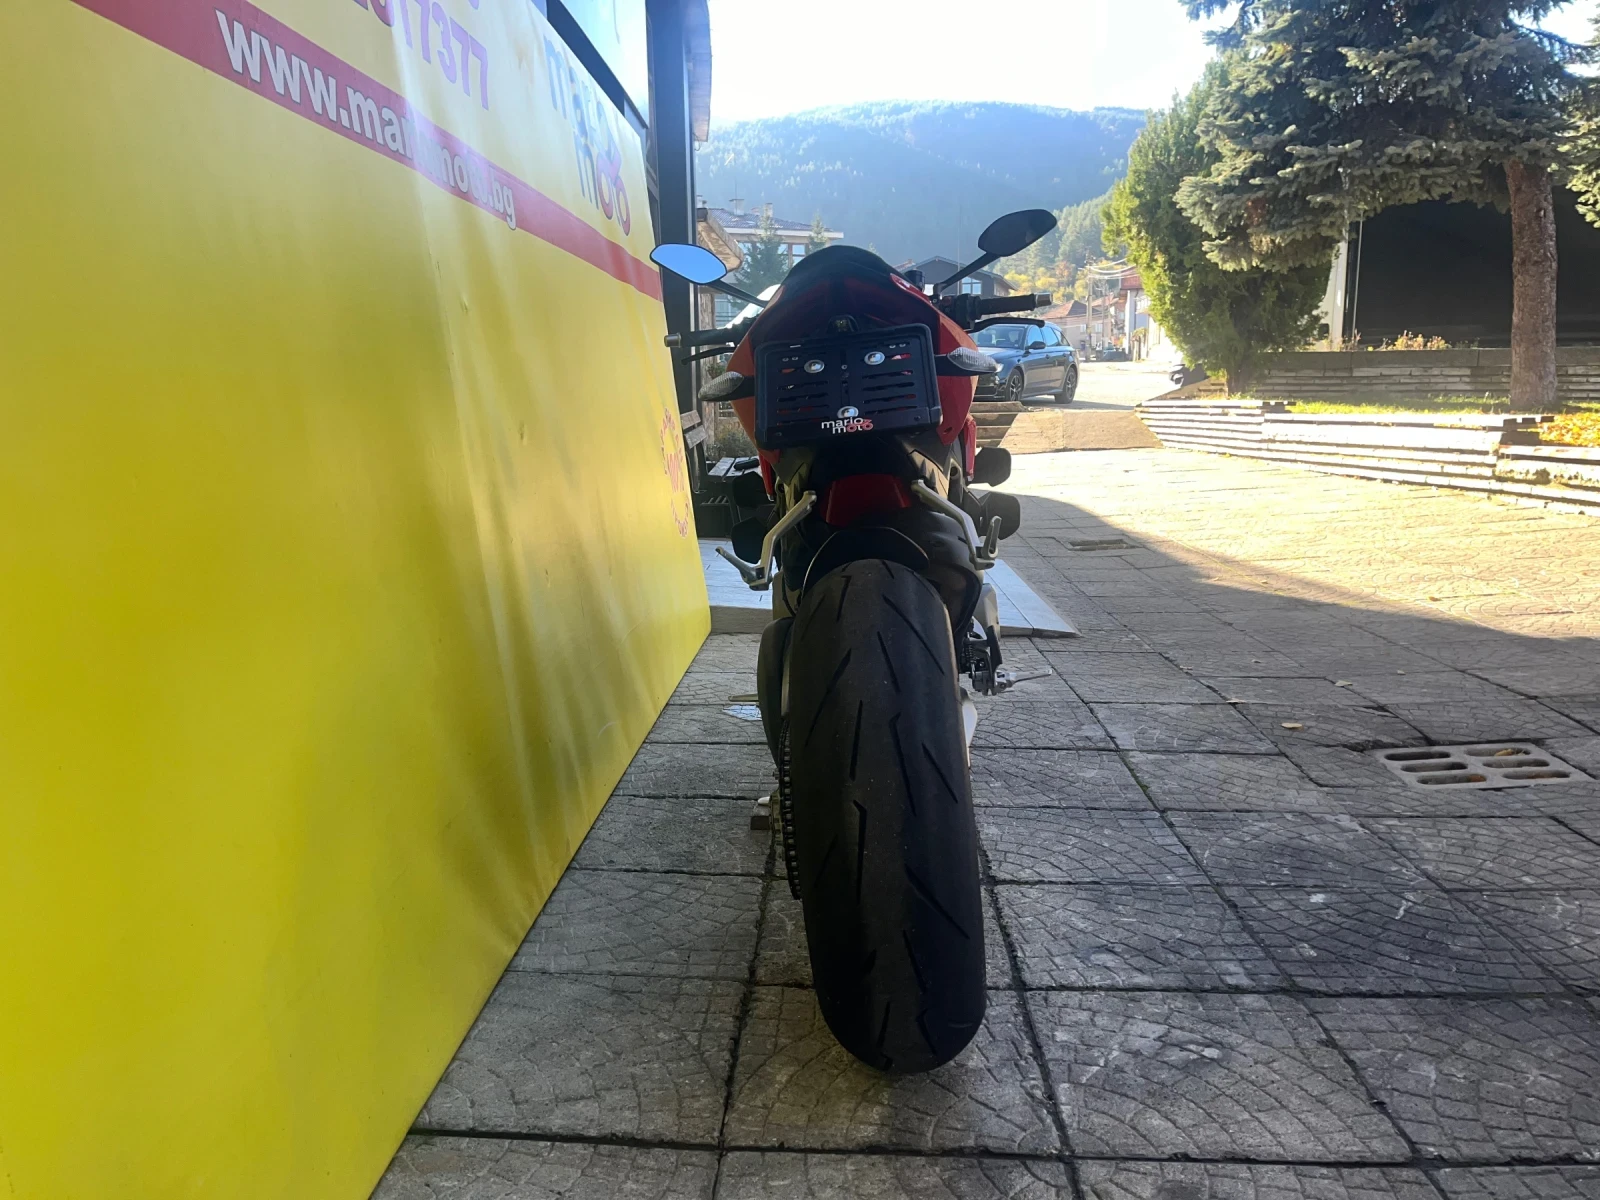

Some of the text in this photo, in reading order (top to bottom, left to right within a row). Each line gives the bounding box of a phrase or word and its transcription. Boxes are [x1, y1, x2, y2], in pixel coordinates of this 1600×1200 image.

[215, 8, 516, 231] www.marmo.bg
[821, 416, 864, 429] mario
[832, 421, 873, 434] moto
